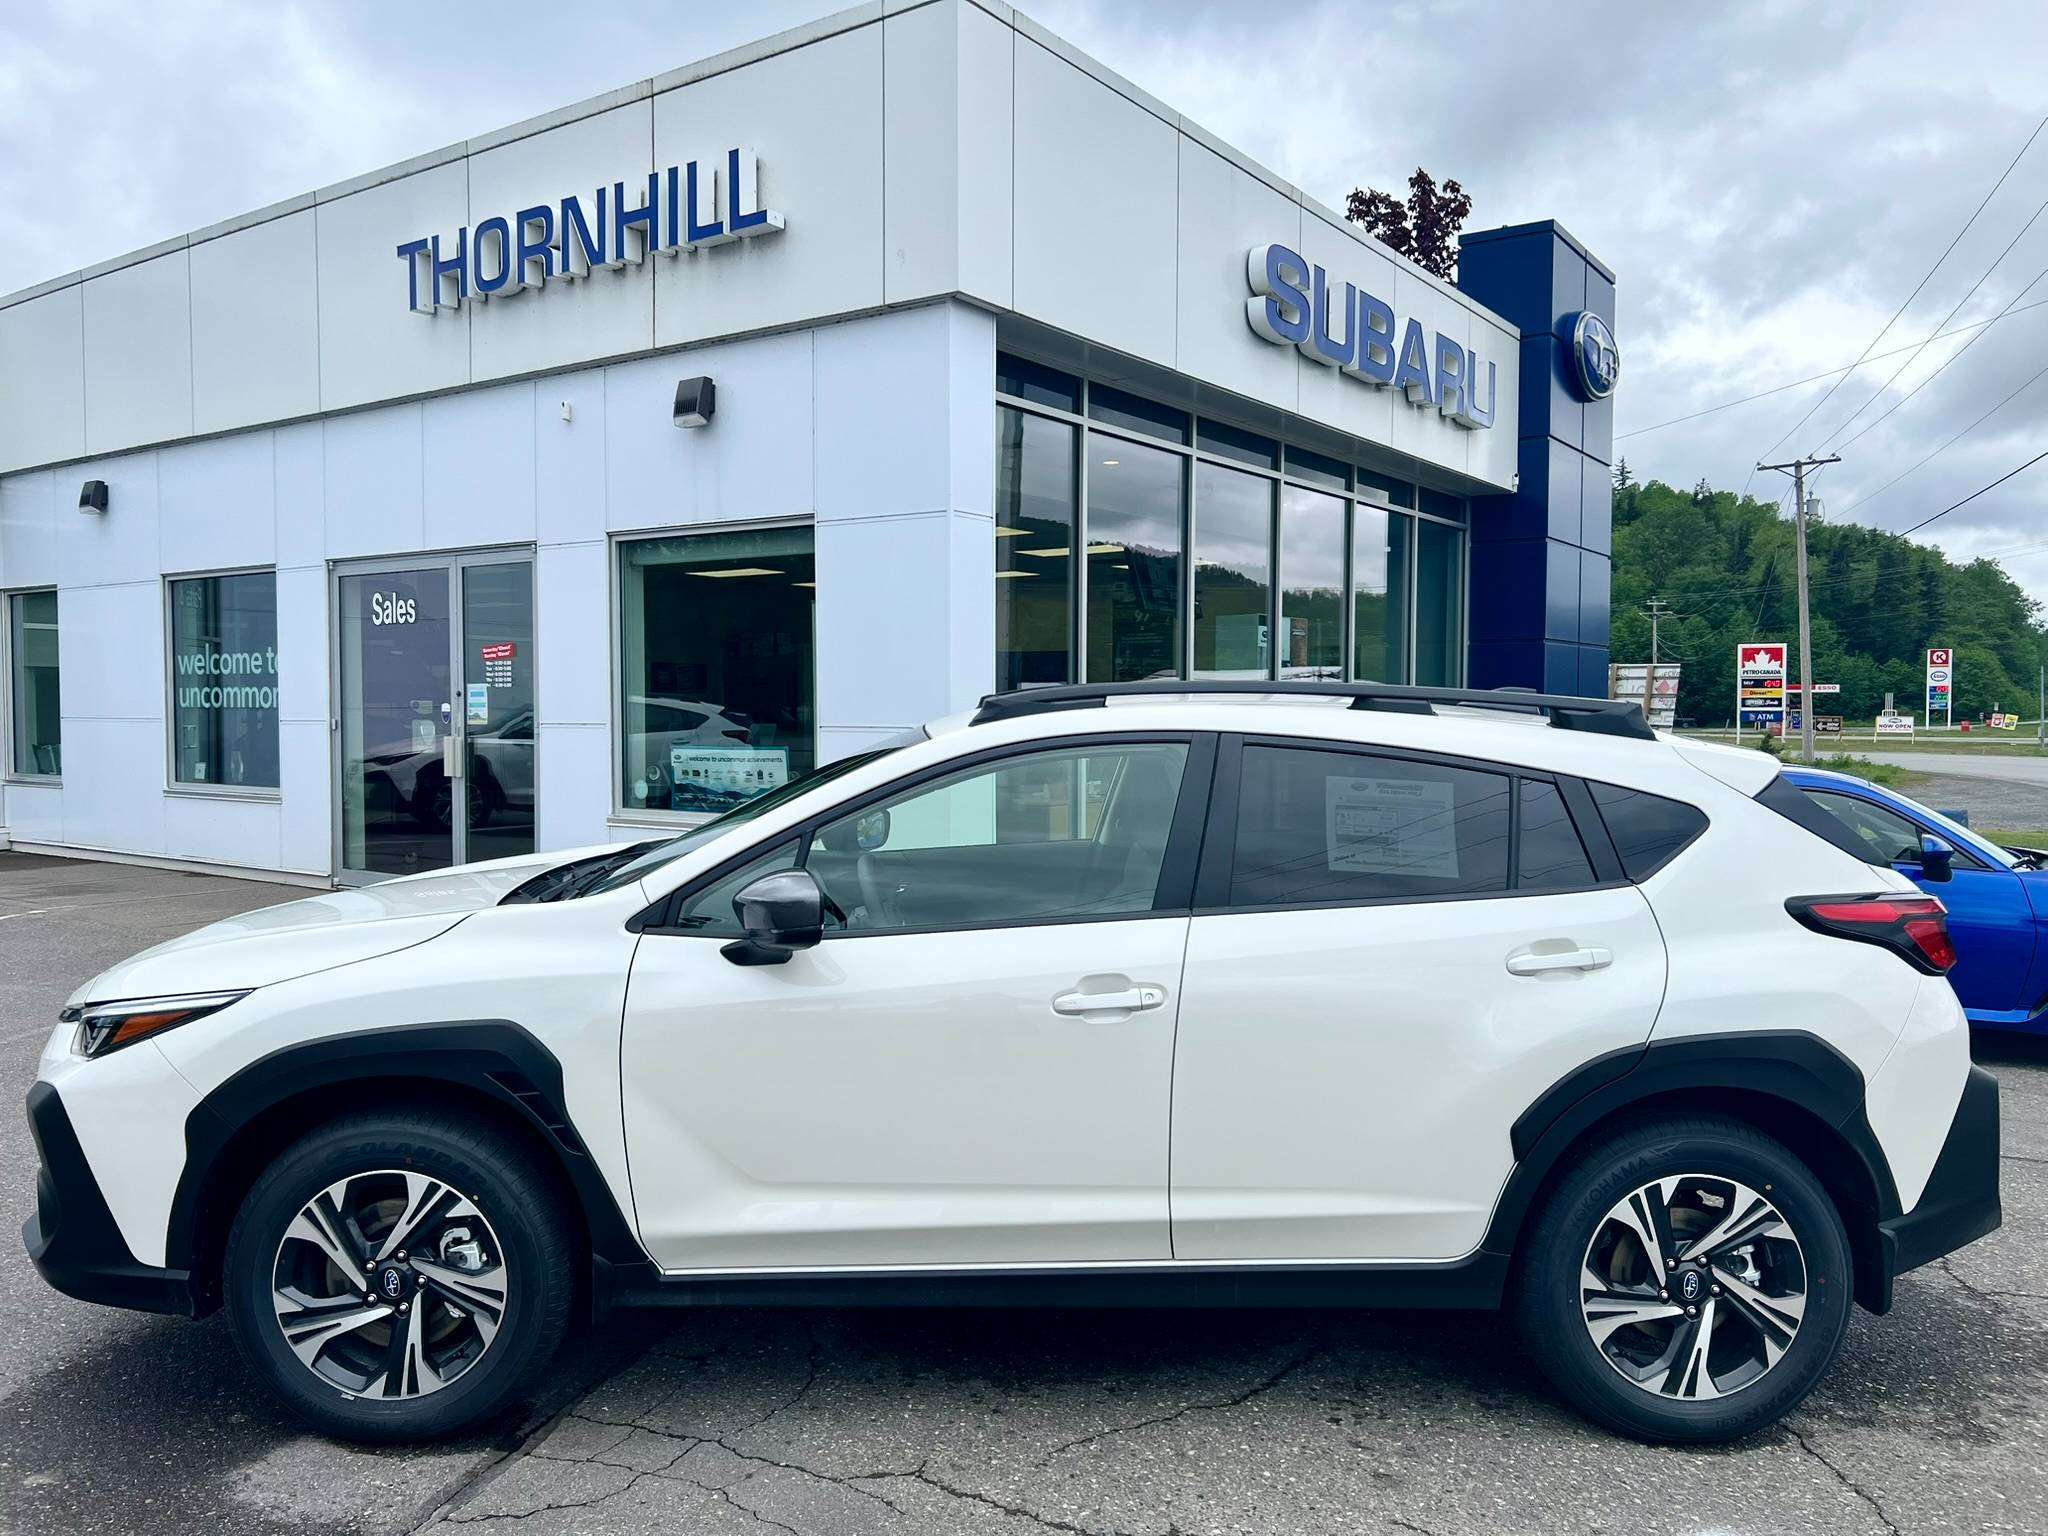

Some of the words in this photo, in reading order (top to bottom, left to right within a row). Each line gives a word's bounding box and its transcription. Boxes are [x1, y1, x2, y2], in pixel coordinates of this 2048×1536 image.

[397, 148, 770, 313] THORNHILL
[1258, 243, 1495, 429] SUBARU
[372, 592, 416, 626] Sales
[178, 643, 263, 675] welcome
[1935, 653, 1944, 662] K
[1566, 1157, 1649, 1231] YOKOHAMA
